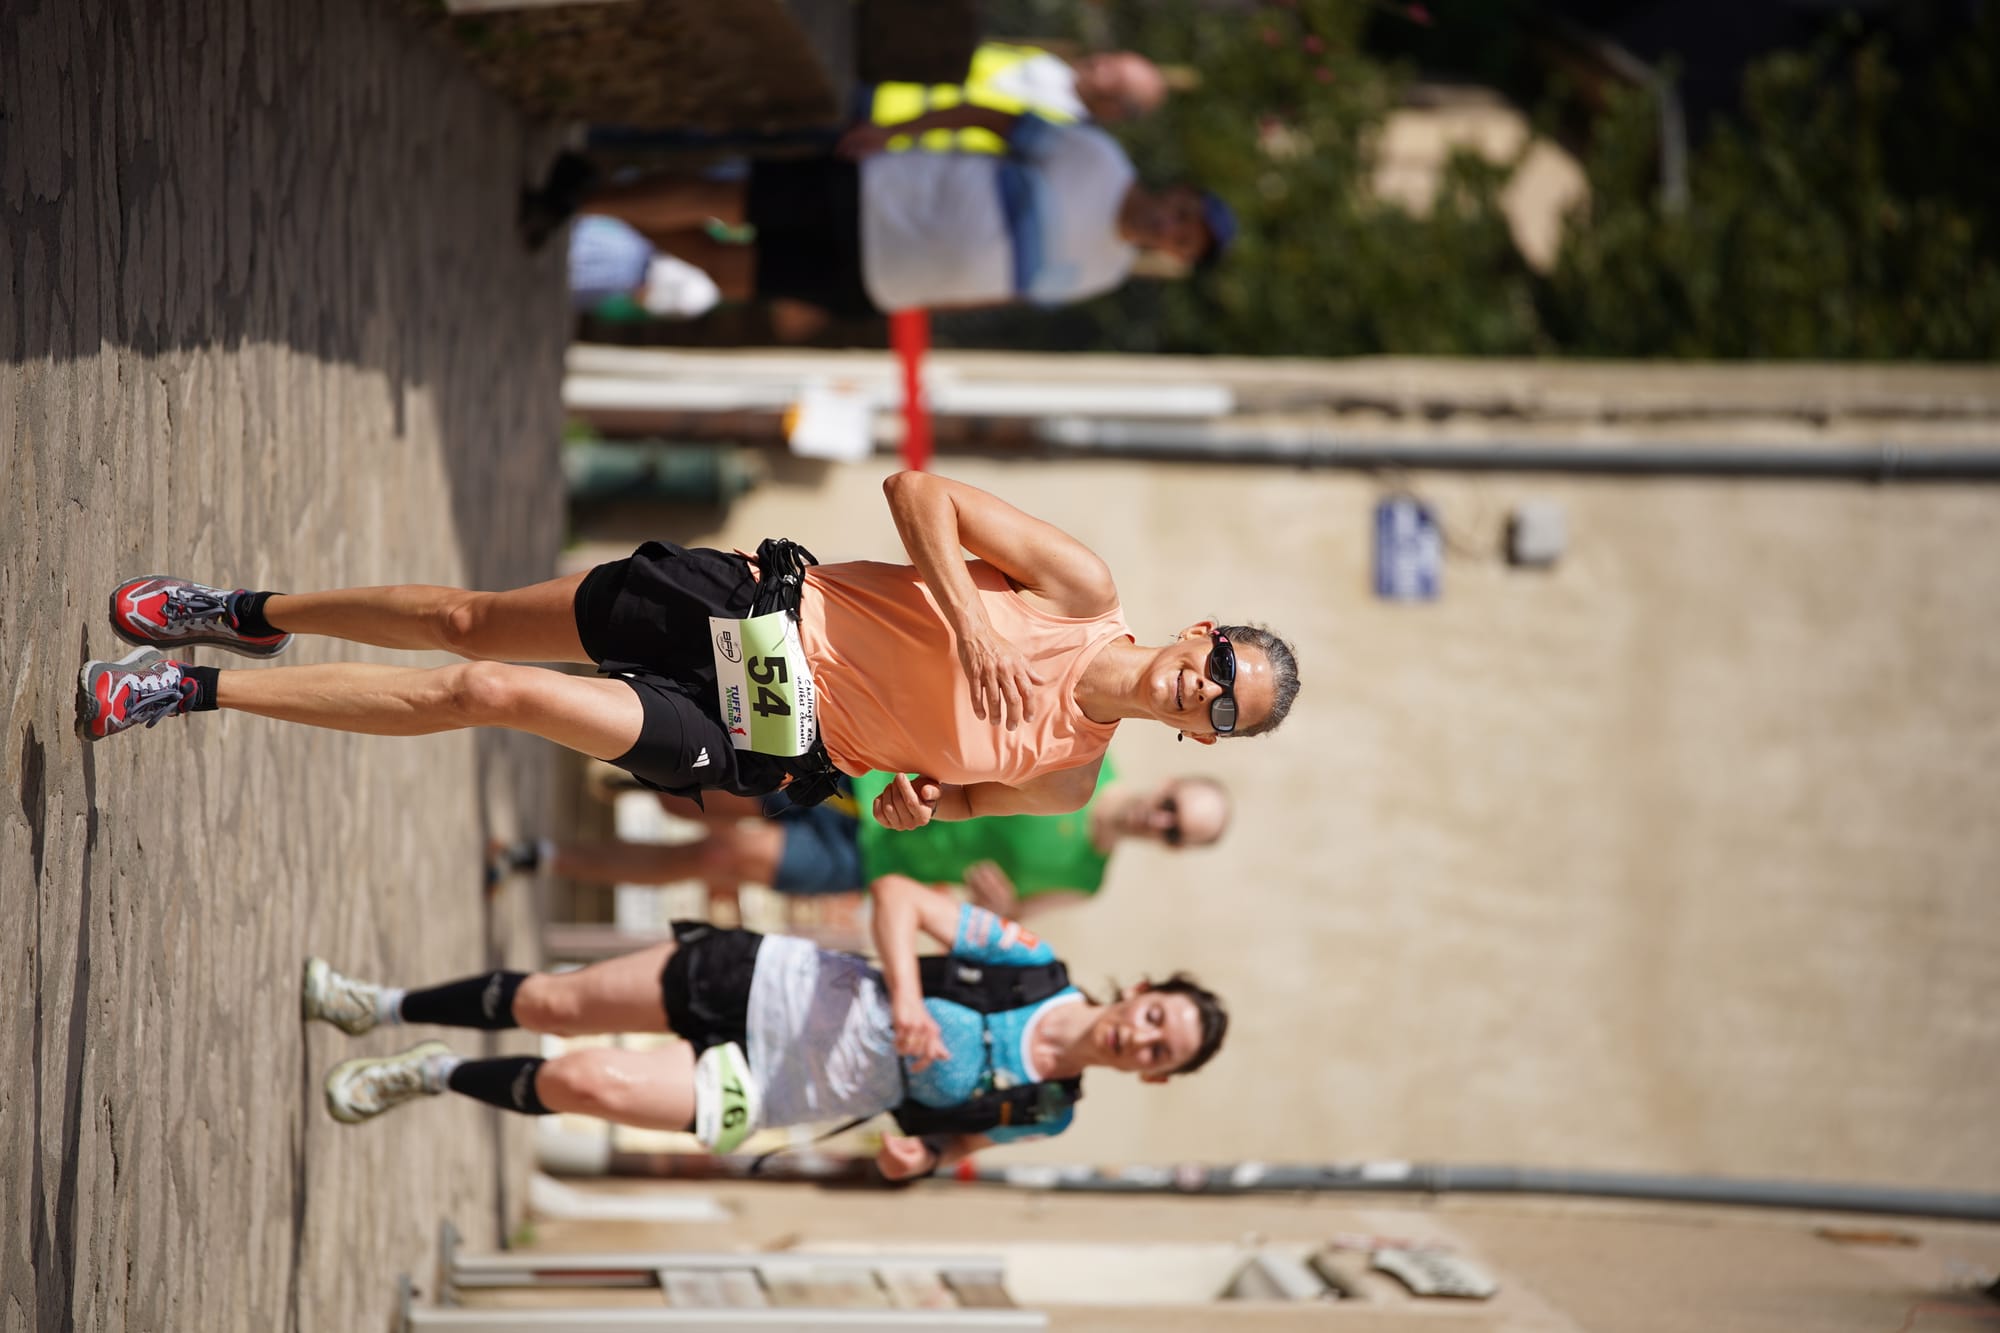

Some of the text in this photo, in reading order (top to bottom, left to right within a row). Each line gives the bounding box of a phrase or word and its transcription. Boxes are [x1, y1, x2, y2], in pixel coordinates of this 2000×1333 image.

[722, 630, 734, 658] BFP
[725, 687, 735, 727] Aventure
[730, 685, 742, 723] TUFF'S
[747, 656, 791, 717] 54
[805, 679, 813, 722] Challenge
[723, 1077, 746, 1130] 76
